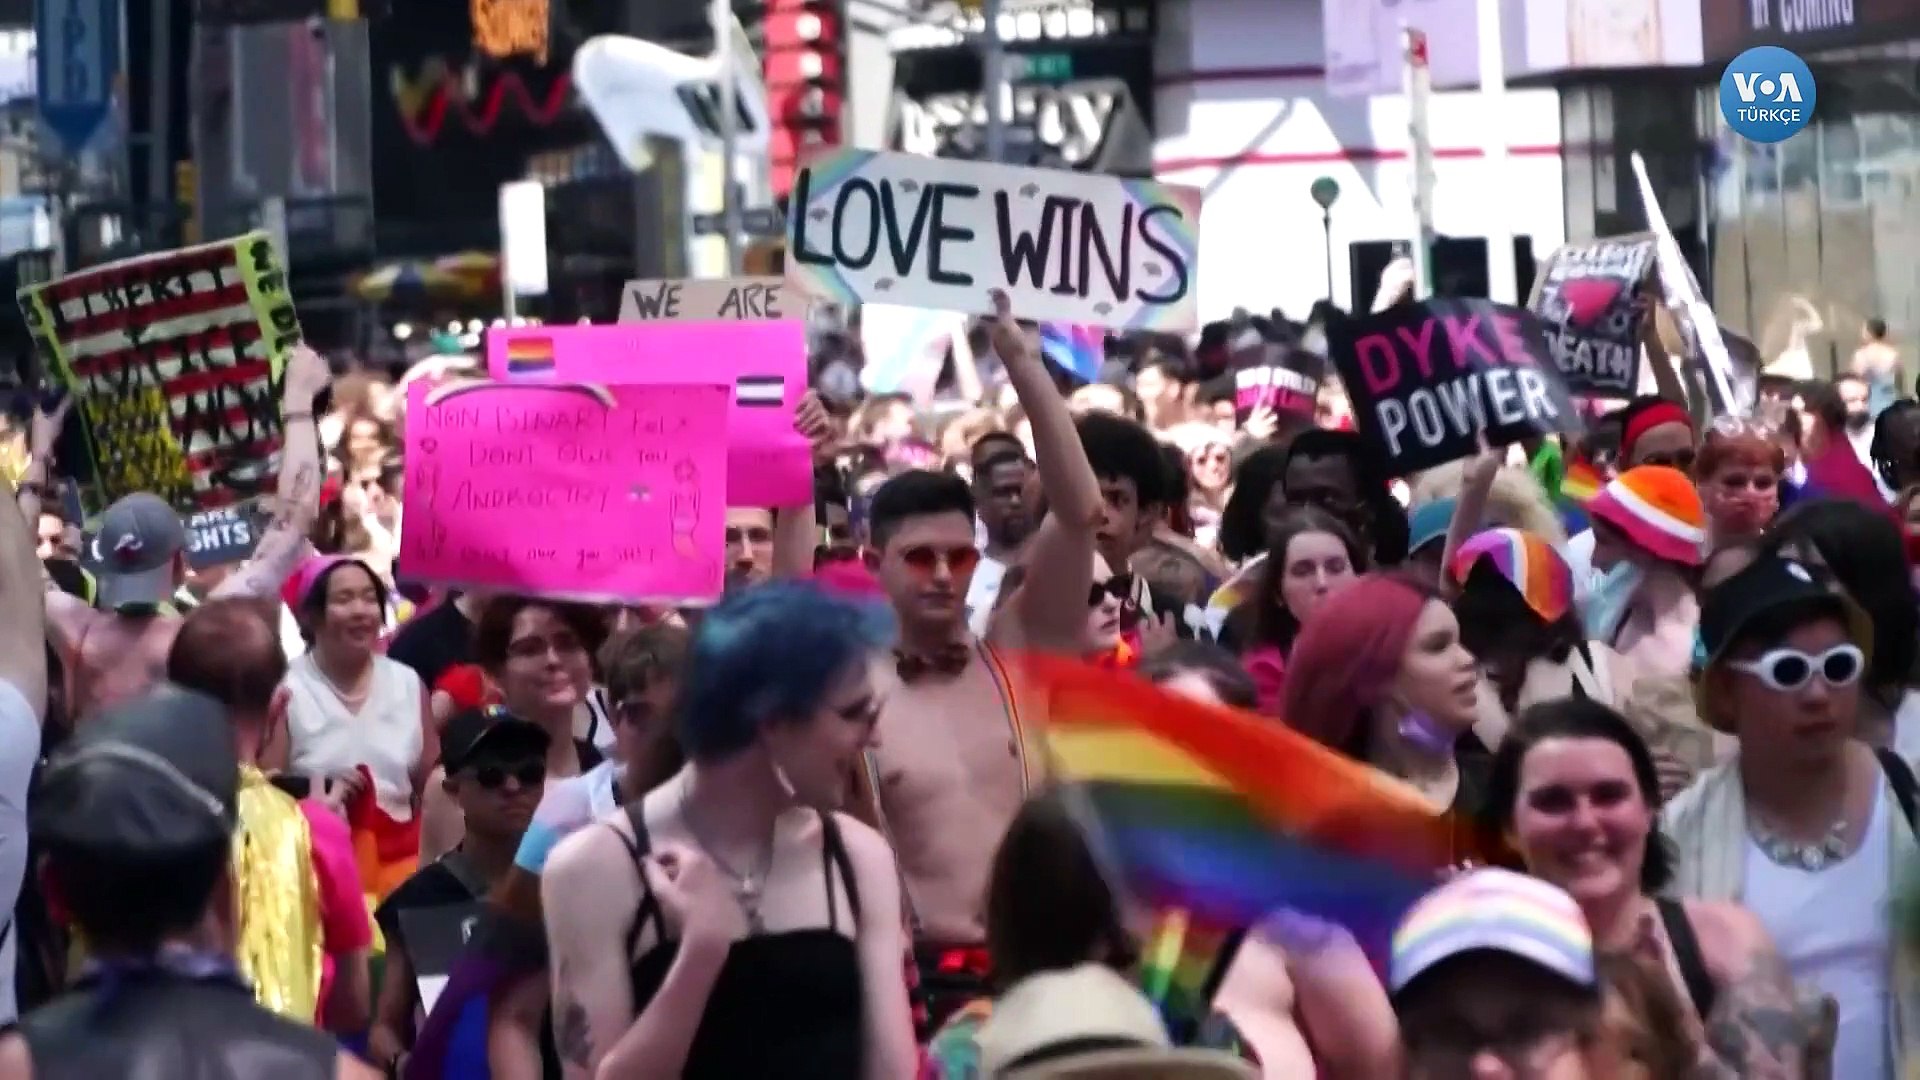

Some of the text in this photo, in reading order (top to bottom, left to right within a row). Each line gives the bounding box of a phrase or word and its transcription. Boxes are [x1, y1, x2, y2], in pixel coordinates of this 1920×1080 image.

[793, 168, 1188, 306] LOVE WINS
[633, 282, 783, 320] WE ARE
[1354, 313, 1535, 394] DYKE
[1376, 367, 1559, 456] POWER
